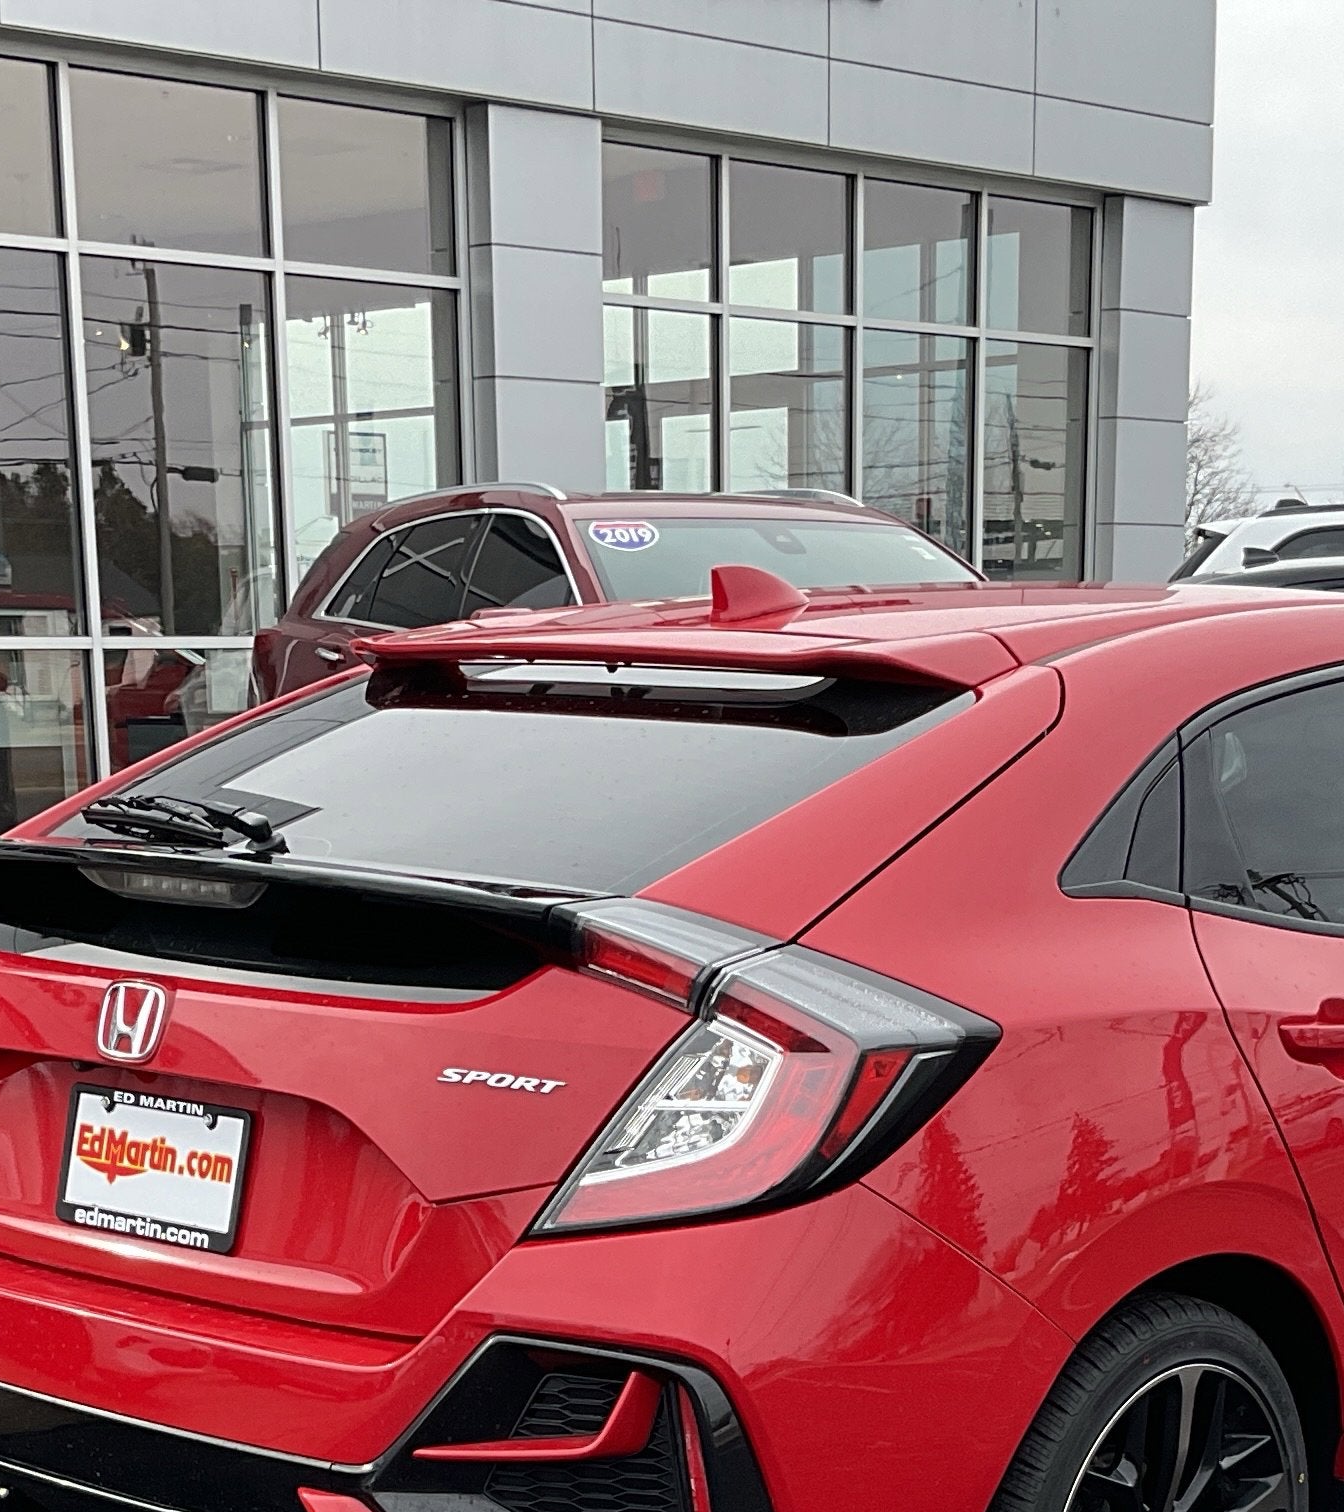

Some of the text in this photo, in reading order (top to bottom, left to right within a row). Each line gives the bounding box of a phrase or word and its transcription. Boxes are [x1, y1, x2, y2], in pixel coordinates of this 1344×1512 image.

[600, 527, 652, 543] 2019
[436, 1067, 568, 1094] SPORT
[113, 1090, 205, 1117] ED MARTIN
[76, 1123, 234, 1184] EdMartin.com
[73, 1206, 210, 1249] edmartin.com
